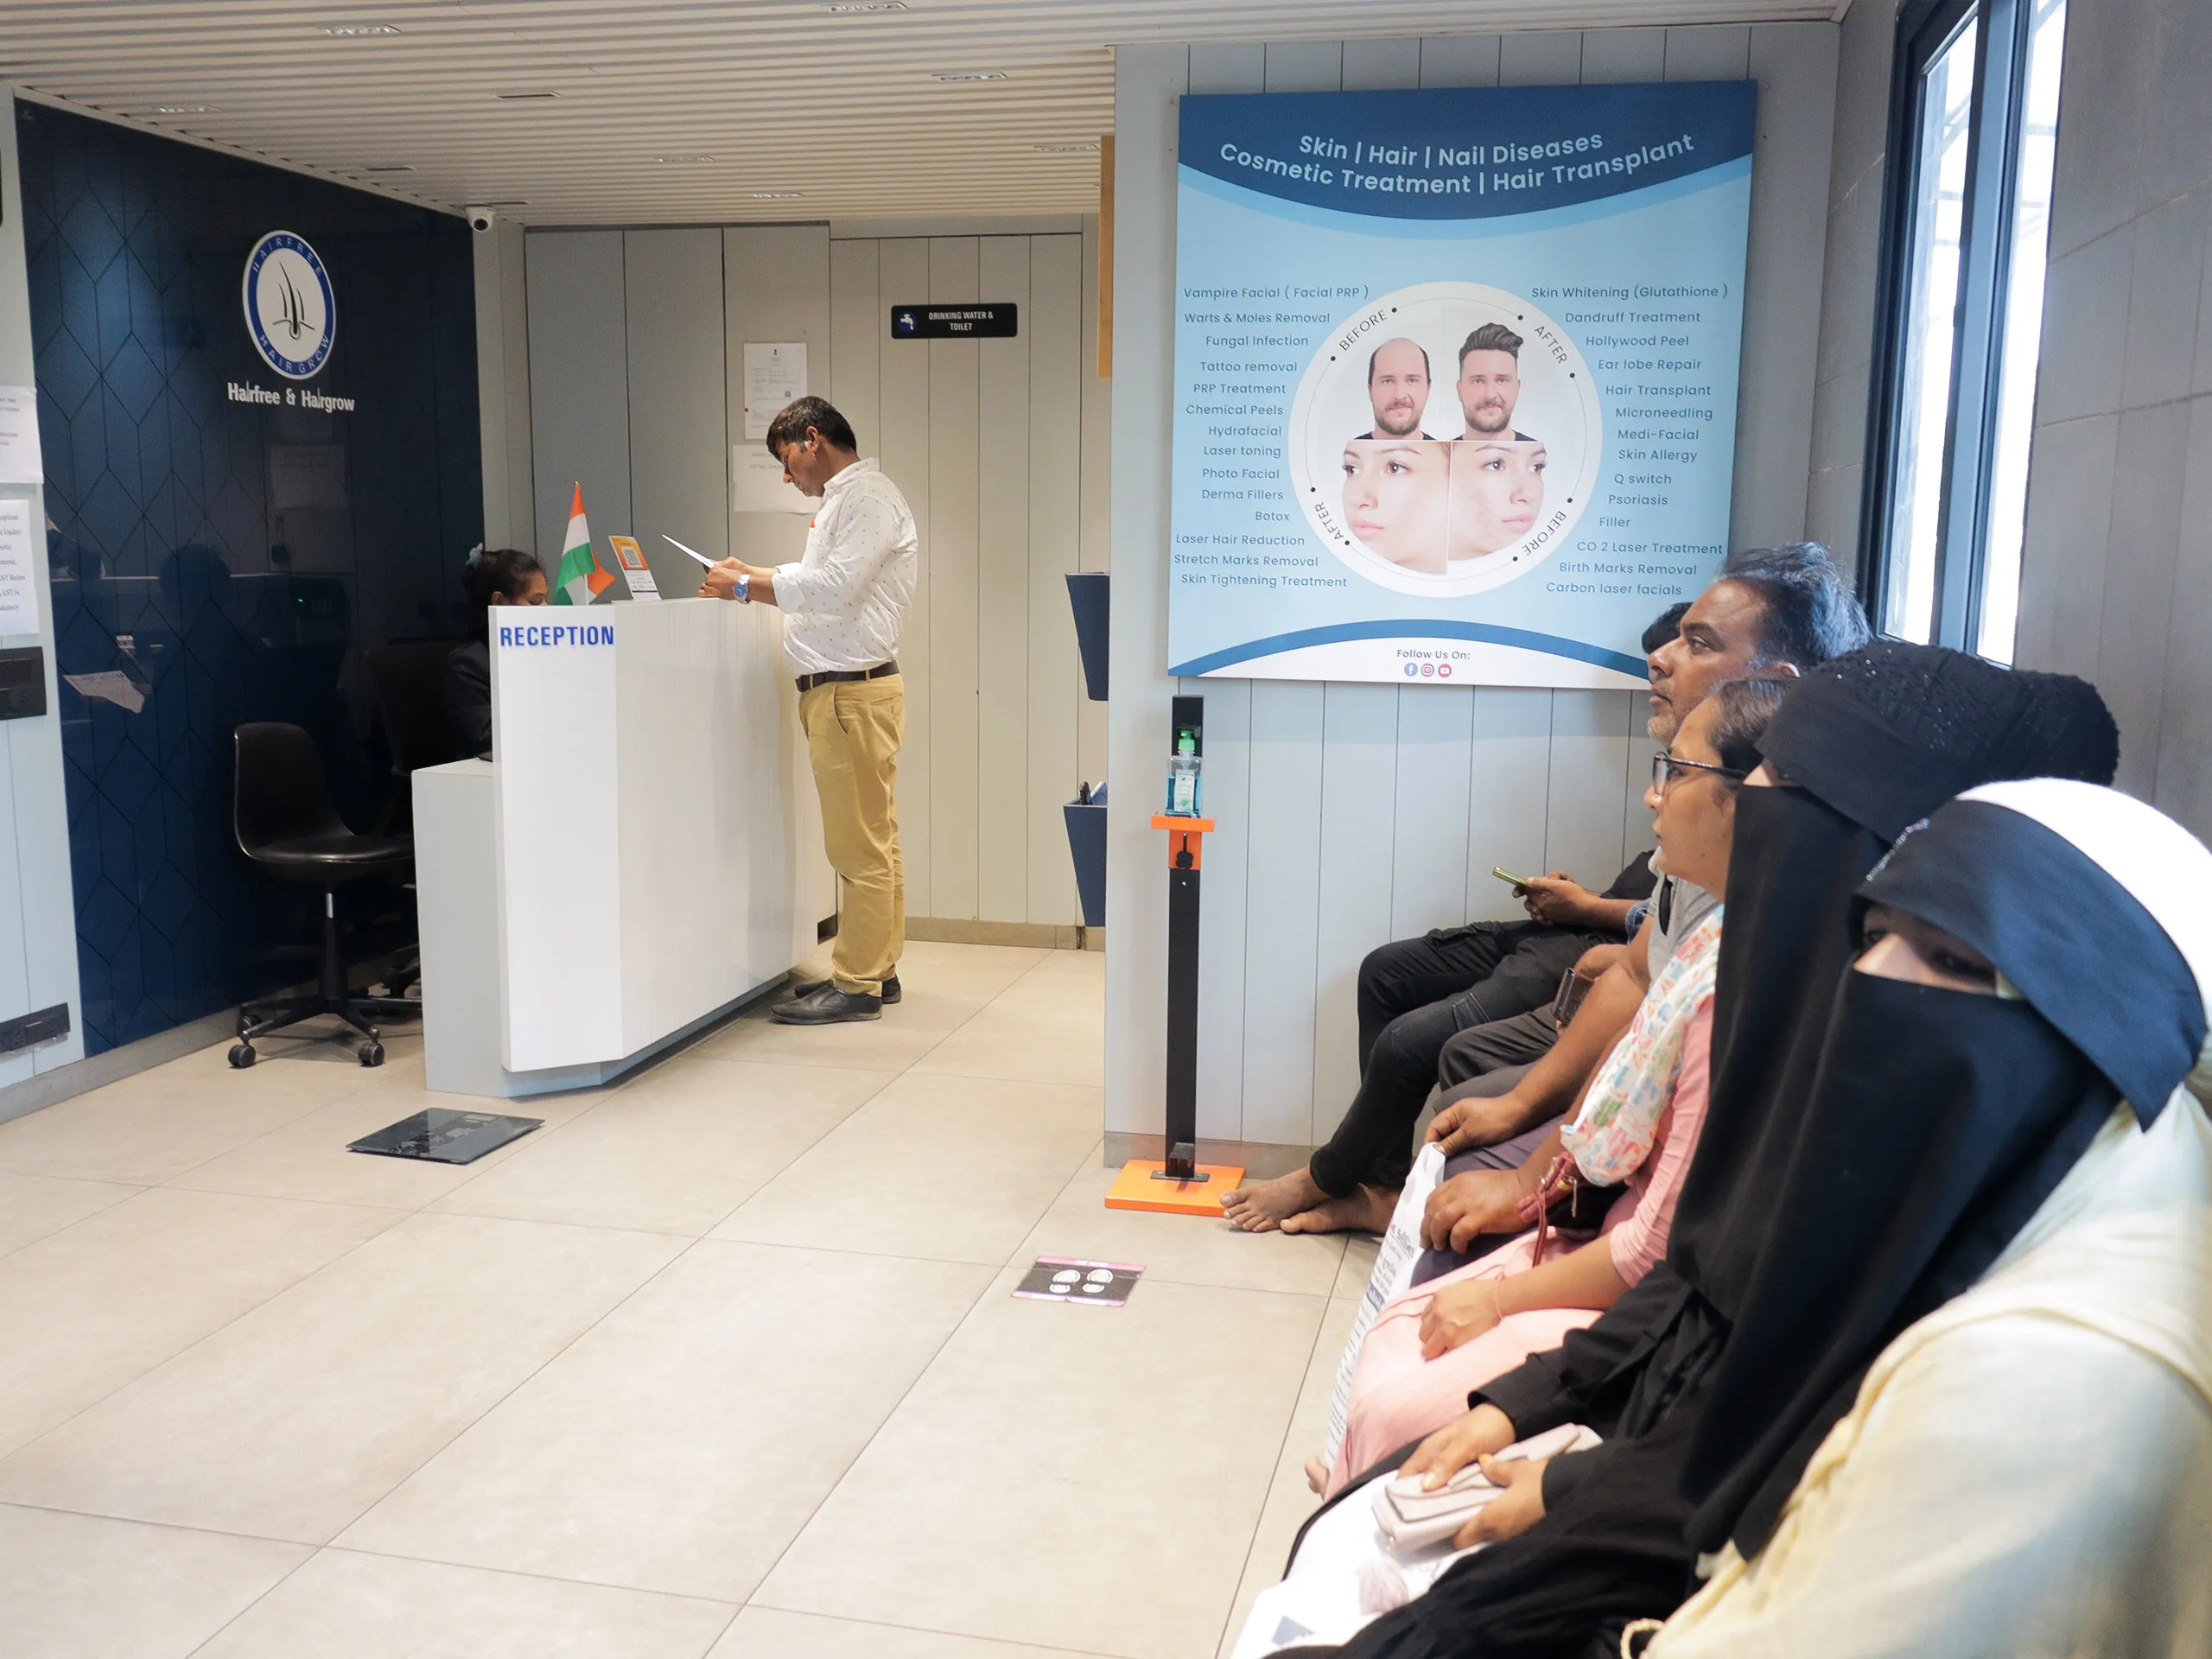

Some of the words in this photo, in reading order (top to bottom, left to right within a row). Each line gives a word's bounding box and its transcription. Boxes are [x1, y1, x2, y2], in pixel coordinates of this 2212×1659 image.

[1299, 135, 1348, 160] Skin
[1369, 145, 1417, 166] Hair
[1439, 145, 1484, 166] Nail
[1493, 134, 1603, 164] Diseases
[1220, 143, 1334, 185] Cosmetic
[1341, 169, 1471, 194] Treatment
[1493, 168, 1544, 191] Hair
[1552, 134, 1694, 183] Transplant
[252, 237, 321, 277] HAIRFREE
[1183, 287, 1237, 301] Vampire
[1242, 286, 1280, 297] Facial
[1294, 286, 1332, 297] Facial
[1336, 287, 1359, 297] PRP
[1531, 286, 1558, 297] Skin
[1561, 286, 1629, 301] Whitening
[1633, 283, 1718, 299] (Glutathione
[1184, 313, 1220, 323] Warts
[1223, 312, 1232, 322] &
[1236, 312, 1271, 323] Moles
[1275, 312, 1330, 322] Removal
[1565, 311, 1624, 322] Dandruff
[1629, 312, 1700, 322] Treatment
[950, 322, 973, 331] TOILET
[1338, 309, 1388, 352] BEFORE
[1205, 335, 1249, 348] Fungal
[1252, 334, 1308, 346] Infection
[1534, 325, 1567, 365] AFTER
[1586, 334, 1656, 349] Hollywood
[1660, 334, 1688, 346] Peel
[259, 334, 329, 374] HAIRGROW
[1199, 361, 1241, 371] Tattoo
[1244, 361, 1297, 372] removal
[1598, 359, 1619, 369] Ear
[1624, 359, 1653, 369] lobe
[1656, 359, 1701, 372] Repair
[1193, 383, 1216, 393] PRP
[1219, 383, 1286, 393] Treatment
[1605, 384, 1632, 395] Hair
[1637, 385, 1711, 398] Transplant
[227, 381, 281, 405] Hairfree
[286, 388, 296, 405] &
[302, 387, 355, 413] Hairgrow
[1185, 404, 1246, 415] Chemical
[1250, 404, 1283, 415] Peels
[1615, 406, 1713, 422] Microneedling
[1208, 424, 1281, 438] Hydrafacial
[1618, 428, 1699, 440] Medi-Facial
[1204, 445, 1236, 455] Laser
[1240, 445, 1281, 459] toning
[1618, 448, 1645, 460] Skin
[1649, 448, 1697, 463] Allergy
[1202, 467, 1237, 478] Photo
[1242, 468, 1279, 479] Facial
[1613, 473, 1624, 485] Q
[1628, 473, 1671, 484] switch
[1201, 488, 1243, 499] Derma
[1247, 488, 1283, 499] Fillers
[1608, 493, 1668, 505] Psoriasis
[1255, 511, 1289, 521] Botox
[1314, 501, 1344, 540] AFTER
[1599, 516, 1630, 527] Filler
[1176, 533, 1209, 543] Laser
[1212, 534, 1237, 543] Hair
[1241, 534, 1305, 545] Reduction
[1521, 510, 1567, 556] BEFORE
[1576, 541, 1597, 551] CO
[1600, 541, 1608, 551] 2
[1612, 542, 1648, 552] Laser
[1651, 542, 1722, 554] Treatment
[1173, 554, 1218, 564] Stretch
[1222, 555, 1259, 565] Marks
[1263, 556, 1318, 566] Removal
[1559, 561, 1589, 572] Birth
[1593, 563, 1633, 573] Marks
[1637, 563, 1696, 575] Removal
[1181, 573, 1206, 583] Skin
[1210, 573, 1276, 588] Tightening
[1281, 575, 1347, 587] Treatment
[1546, 582, 1595, 593] Carbon
[1599, 582, 1632, 594] laser
[1637, 583, 1681, 594] facials
[500, 626, 613, 646] RECEPTION
[1396, 649, 1432, 658] Follow
[1434, 650, 1448, 658] Us
[1451, 650, 1470, 659] On:
